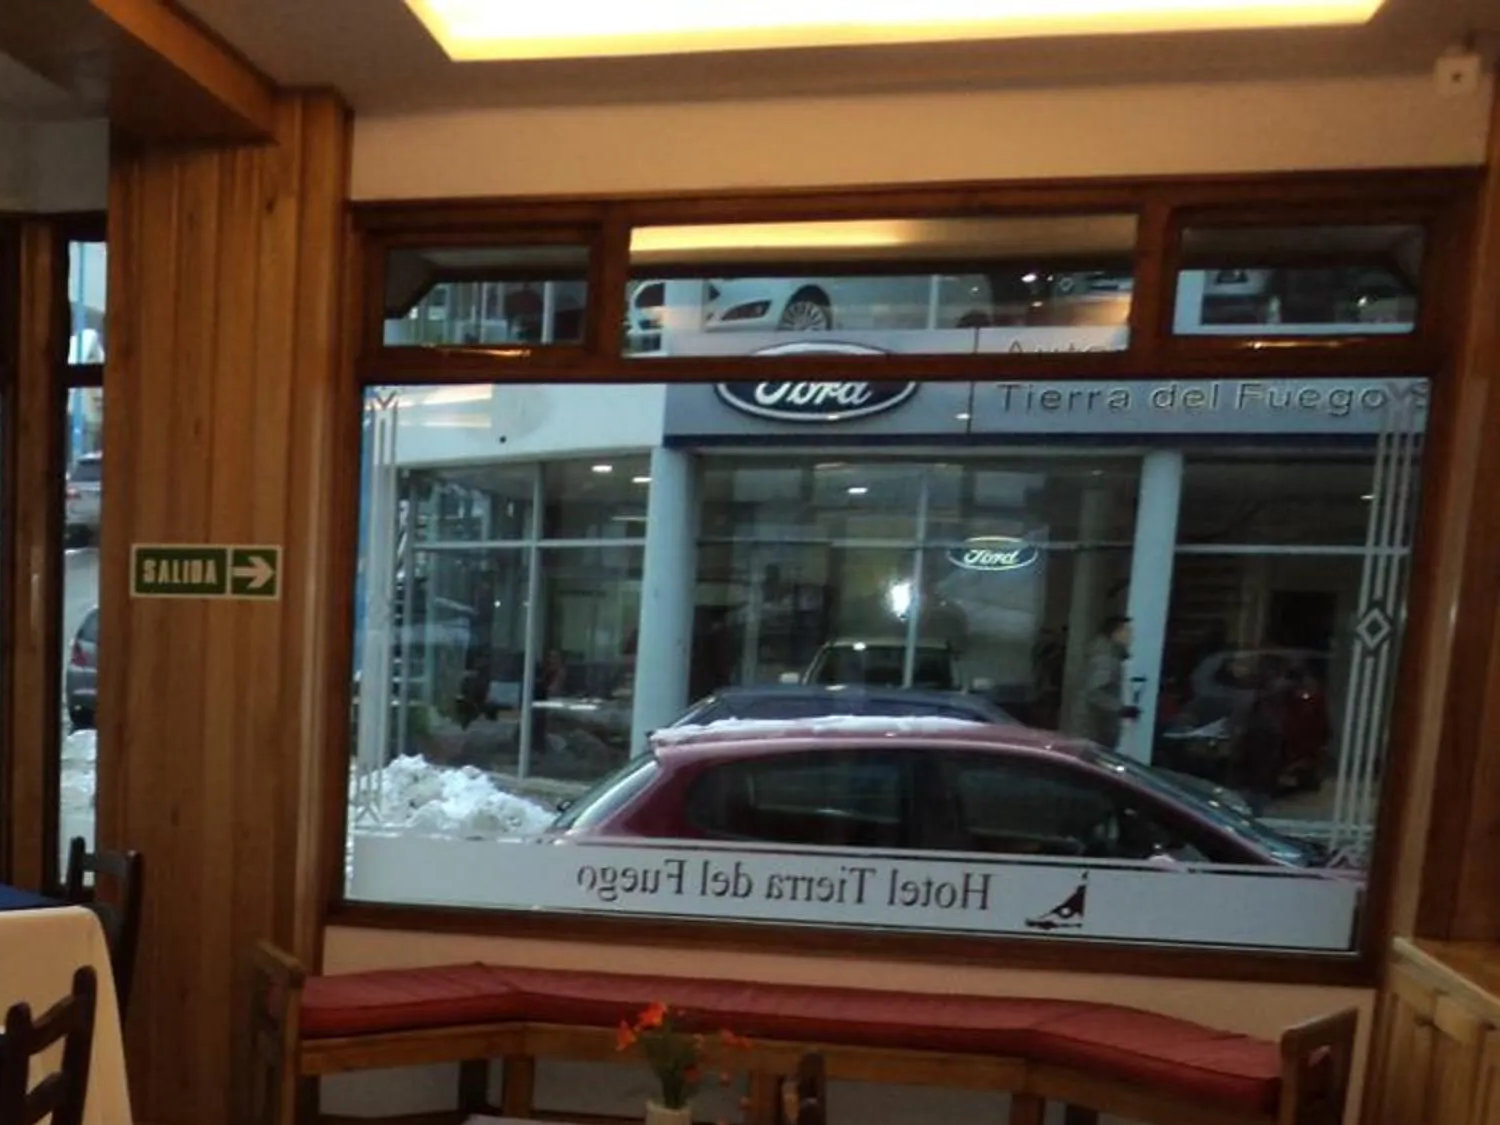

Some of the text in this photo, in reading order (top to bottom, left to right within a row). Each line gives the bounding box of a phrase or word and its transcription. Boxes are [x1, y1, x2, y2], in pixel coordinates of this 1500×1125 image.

[997, 383, 1131, 411] Tierra
[1150, 381, 1219, 411] del
[1236, 382, 1387, 416] Fuego
[963, 548, 1021, 565] Ford
[142, 559, 218, 584] SALIDA
